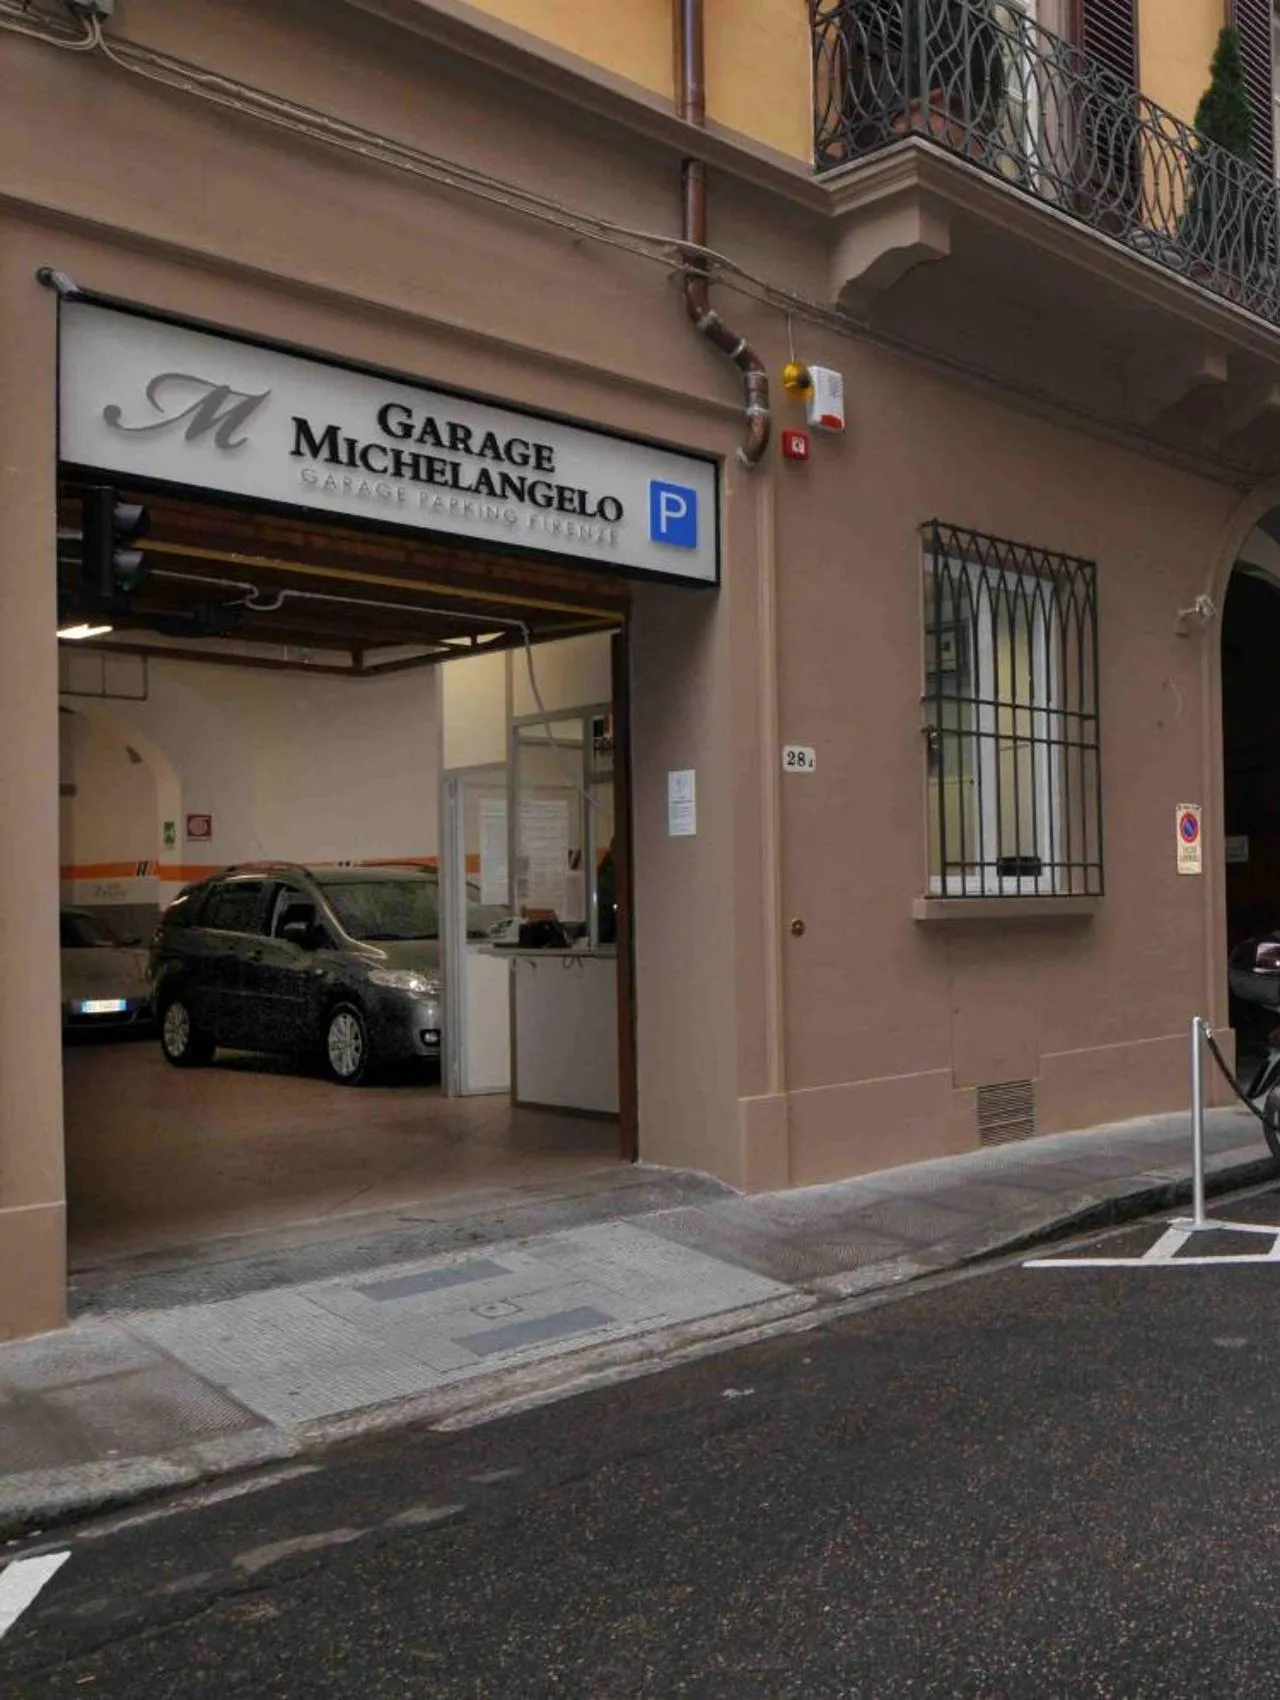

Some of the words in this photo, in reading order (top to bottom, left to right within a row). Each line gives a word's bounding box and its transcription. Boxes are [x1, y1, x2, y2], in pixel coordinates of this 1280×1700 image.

[289, 415, 625, 523] MICHELANGELO
[376, 401, 556, 473] GARAGE
[299, 467, 406, 502] GARAGE
[419, 490, 519, 526] PARKING
[527, 513, 621, 546] FIRENZE
[658, 490, 689, 534] P
